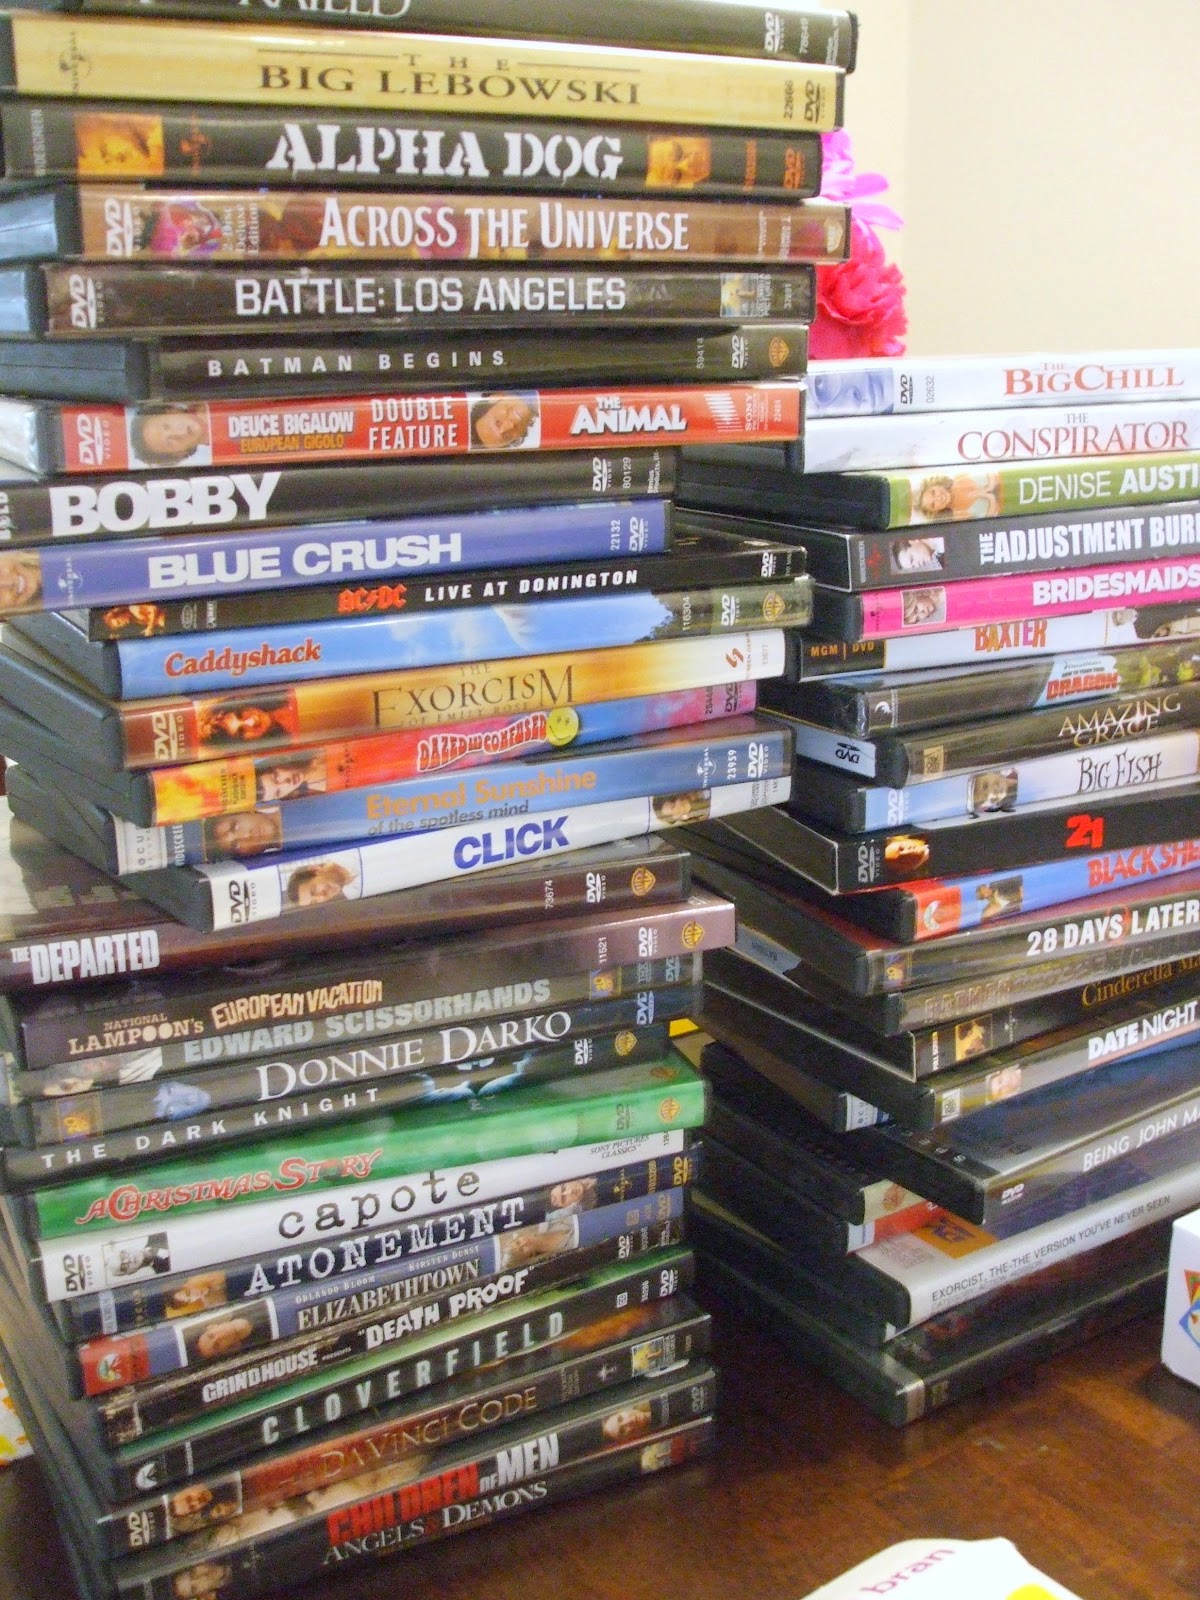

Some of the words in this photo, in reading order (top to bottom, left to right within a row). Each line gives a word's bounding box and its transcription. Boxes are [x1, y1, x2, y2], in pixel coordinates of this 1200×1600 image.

[764, 11, 775, 52] DVD
[403, 53, 510, 71] THE
[260, 64, 355, 92] BIG
[377, 69, 641, 105] LEBOWSKI
[804, 80, 815, 122] DVD
[265, 123, 490, 179] ALPHA
[503, 133, 624, 184] DOG
[104, 197, 123, 258] DVD
[319, 197, 457, 249] ACROSS
[464, 207, 529, 259] THE
[540, 201, 689, 251] UNIVERSE
[69, 273, 86, 329] DVD
[235, 278, 386, 316] BATTLE:
[395, 277, 463, 312] LOS
[474, 276, 626, 312] ANGELES
[207, 355, 352, 378] BATMAN
[379, 350, 504, 371] BEGINS
[732, 335, 740, 369] DVD
[1040, 362, 1066, 372] THE
[596, 395, 621, 411] THE
[900, 373, 909, 405] DVD
[926, 374, 935, 404] 02632
[228, 414, 279, 438] DEUCE
[283, 411, 355, 436] BIGALOW
[372, 395, 454, 422] DOUBLE
[570, 404, 688, 435] ANIMAL
[745, 393, 753, 431] SONY
[1064, 412, 1088, 425] THE
[77, 414, 94, 465] DVD
[240, 436, 300, 454] EUROPEAN
[303, 435, 345, 451] GIGOLO
[368, 424, 459, 451] FEATURE
[957, 420, 1189, 461] CONSPIRATOR
[592, 457, 602, 492] DVD
[622, 457, 631, 489] 80129
[1019, 470, 1111, 505] DENISE
[1119, 462, 1200, 495] AUSTI
[49, 472, 282, 537] BOBBY
[610, 519, 621, 551] 22132
[629, 517, 641, 552] DVD
[979, 532, 995, 566] THE
[994, 517, 1144, 565] ADJUSTMENT
[148, 547, 282, 589] BLUE
[293, 532, 462, 577] CRUSH
[761, 552, 769, 577] DVD
[425, 583, 472, 602] LIVE
[484, 582, 508, 596] AT
[519, 569, 639, 595] DONINGTON
[1033, 563, 1200, 607] BRIDESMAIDS
[721, 594, 732, 626] DVD
[810, 645, 838, 657] MGM
[852, 640, 875, 654] DVD
[974, 619, 1048, 652] BAXTER
[164, 638, 322, 678] Caddyshack
[460, 662, 491, 677] THE
[374, 664, 575, 730] EXORCISM
[1046, 672, 1118, 700] DRAGON
[437, 709, 483, 723] EMILY
[493, 701, 530, 714] ROSE
[1058, 693, 1181, 737] AMAZING
[1073, 714, 1159, 747] GRACE
[151, 712, 170, 761] DVD
[417, 733, 467, 773] DAZED
[482, 712, 547, 755] CONFUSED
[727, 749, 737, 780] 23959
[747, 742, 758, 778] DVD
[1076, 755, 1111, 794] BIG
[1114, 747, 1163, 785] FISH
[366, 782, 467, 819] Eternal
[475, 770, 597, 804] Sunshine
[368, 821, 385, 836] of
[388, 816, 414, 832] the
[420, 807, 485, 830] spotless
[488, 799, 529, 819] mind
[1065, 814, 1105, 849] 21
[453, 815, 570, 870] CLICK
[858, 845, 868, 882] DVD
[1087, 844, 1159, 889] BLACK
[229, 879, 243, 923] DVD
[545, 879, 554, 910] 73674
[586, 872, 596, 904] DVD
[638, 926, 649, 957] DVD
[1027, 930, 1057, 957] 28
[1063, 913, 1124, 950] DAYS
[1131, 899, 1200, 935] LATER
[11, 946, 31, 963] THE
[30, 929, 160, 985] DEPARTED
[599, 936, 607, 964] 11521
[211, 993, 304, 1029] EUROPEAN
[305, 979, 383, 1013] VACATION
[1081, 962, 1173, 1008] Cinderella
[103, 1011, 168, 1032] NATIONAL
[184, 1022, 315, 1064] EDWARD
[325, 978, 552, 1038] SCISSORHANDS
[1088, 1022, 1139, 1061] DATE
[1142, 1000, 1199, 1041] NIGHT
[256, 1038, 424, 1101] DONNIE
[440, 1011, 572, 1064] DARKO
[575, 1039, 584, 1065] DVD
[41, 1142, 107, 1169] THE
[136, 1119, 226, 1151] DARK
[254, 1087, 380, 1127] KNIGHT
[590, 1144, 611, 1157] SONY
[612, 1133, 650, 1153] PICTURES
[1083, 1135, 1130, 1172] BEING
[1136, 1114, 1177, 1149] JOHN
[601, 1144, 637, 1160] CLASSICS
[76, 1198, 106, 1225] A
[107, 1171, 271, 1222] CHRISTMAS
[278, 1170, 480, 1240] capote
[244, 1197, 525, 1297] ATONEMENT
[408, 1253, 447, 1271] KIRSTEN
[450, 1244, 481, 1261] DUNST
[617, 1235, 626, 1259] DVD
[931, 1272, 987, 1303] EXORCIST,
[989, 1252, 1031, 1279] THE-THE
[1034, 1234, 1076, 1259] VERSION
[1077, 1220, 1112, 1241] YOU'VE
[1113, 1206, 1144, 1226] NEVER
[1146, 1195, 1171, 1213] SEEN
[63, 1254, 78, 1292] DVD
[295, 1285, 339, 1305] ORLANDO
[343, 1275, 376, 1292] BLOOM
[660, 1270, 669, 1298] DVD
[296, 1259, 482, 1332] ELIZABETHTOWN
[202, 1347, 319, 1403] GRINDHOUSE
[262, 1311, 564, 1445] CLOVERFIELD
[365, 1416, 450, 1459] VINCI
[458, 1387, 538, 1431] CODE
[327, 1462, 479, 1547] CHILDREN
[496, 1433, 560, 1488] MEN
[129, 1511, 142, 1547] DVD
[323, 1517, 426, 1566] ANGELS
[442, 1480, 548, 1530] DEMONS
